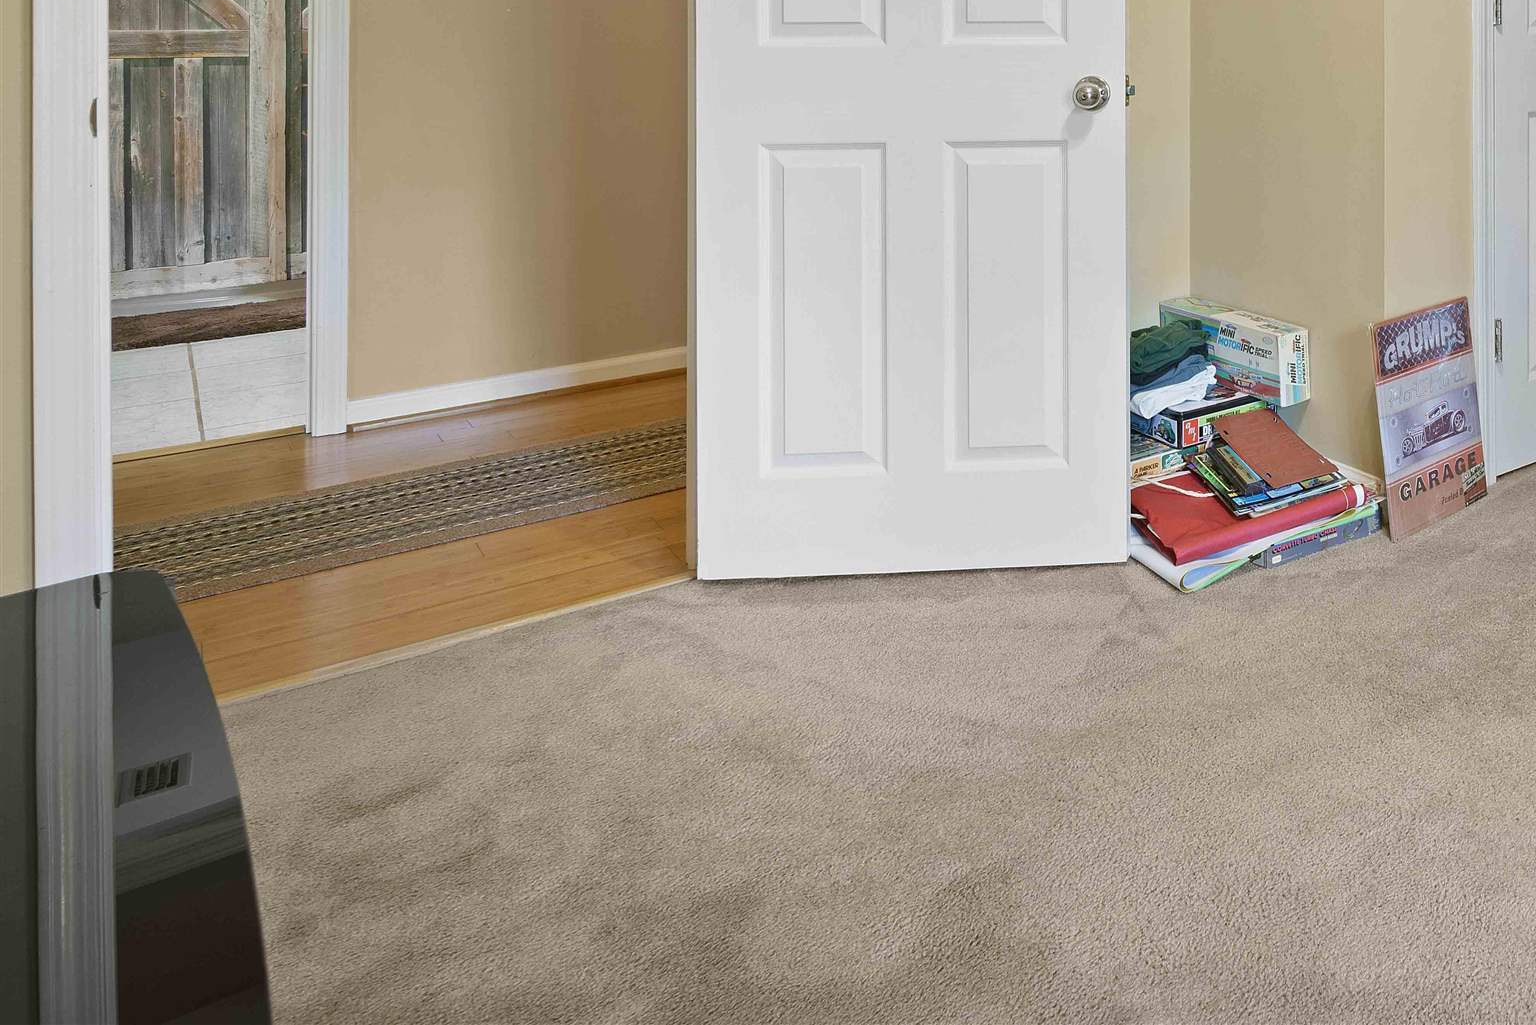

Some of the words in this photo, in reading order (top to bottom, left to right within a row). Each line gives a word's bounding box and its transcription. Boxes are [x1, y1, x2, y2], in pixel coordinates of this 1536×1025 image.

[1217, 336, 1255, 355] MOTORIFIC
[1219, 326, 1236, 339] MINI
[1384, 318, 1466, 370] GRUMP'S
[1399, 451, 1478, 503] GARAGE
